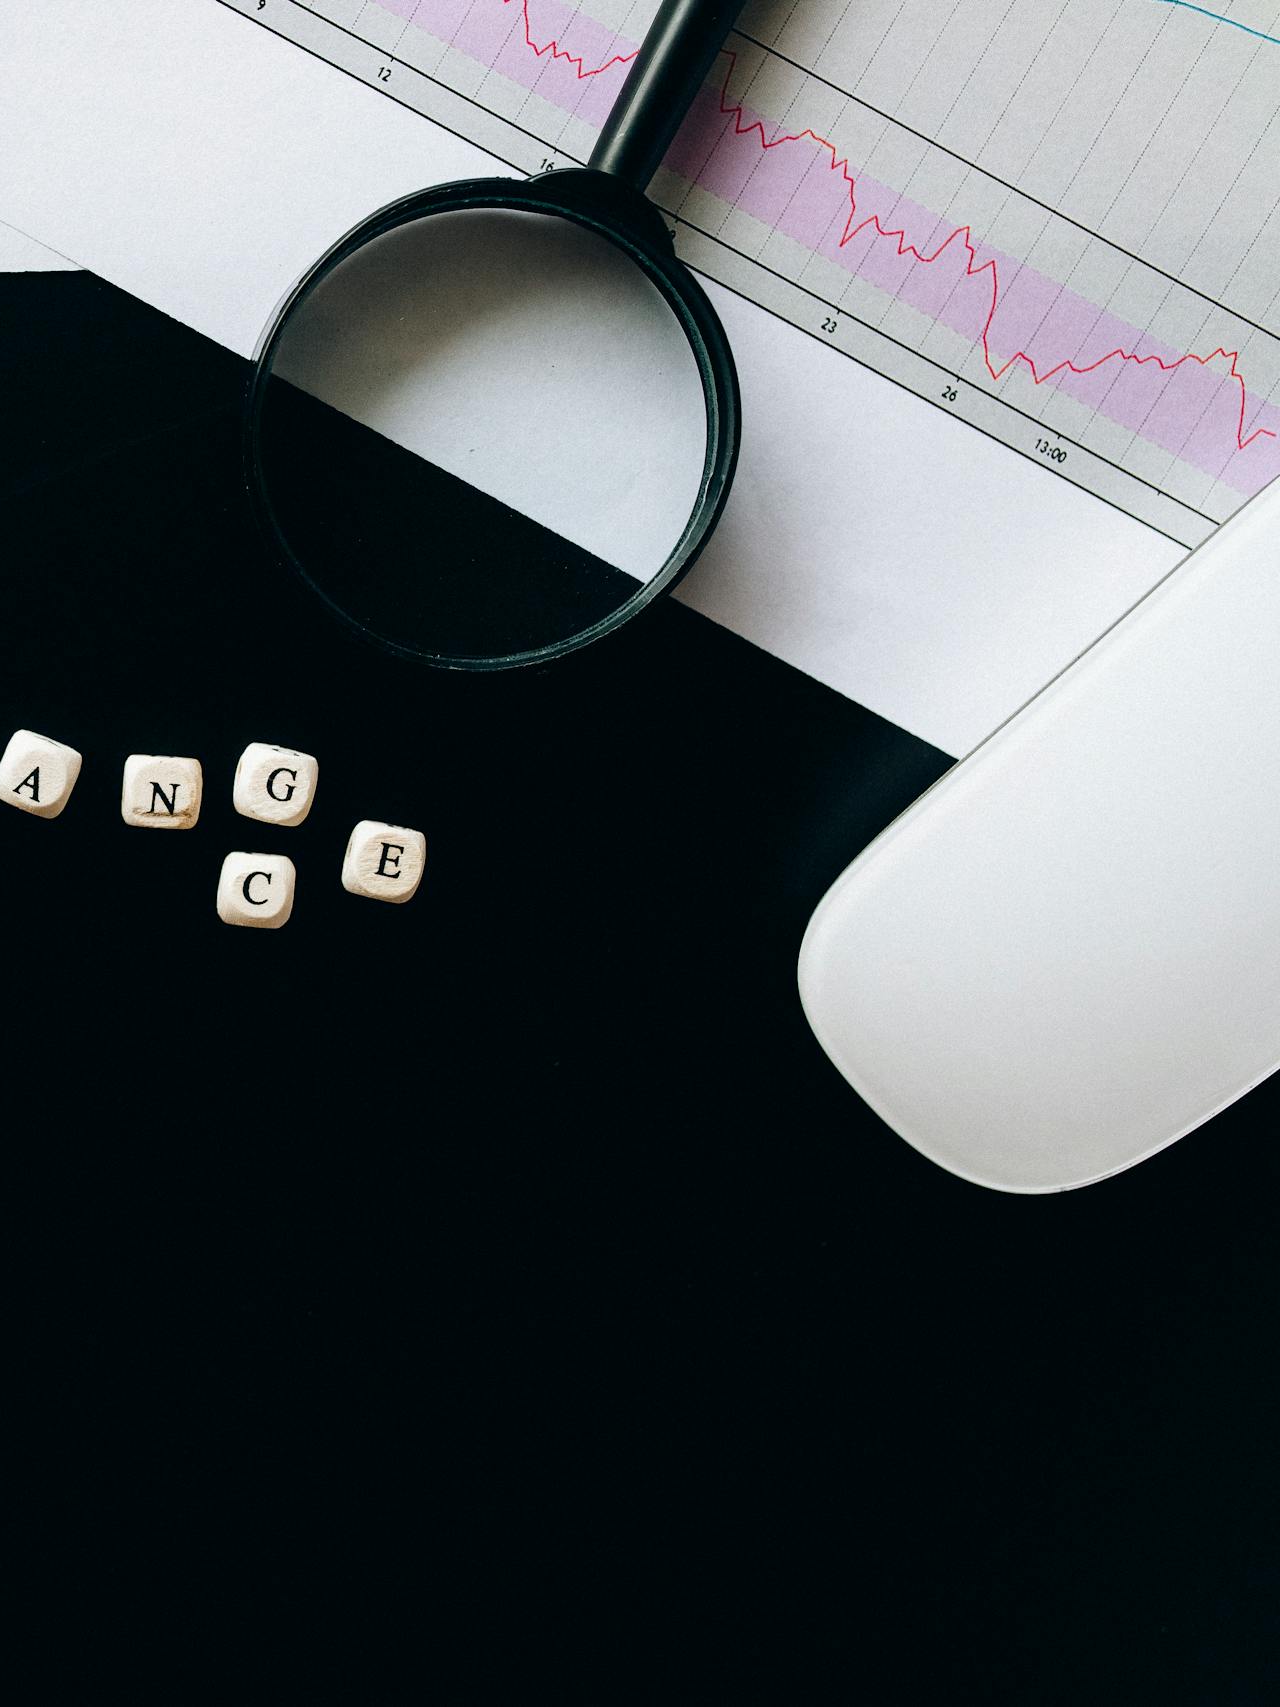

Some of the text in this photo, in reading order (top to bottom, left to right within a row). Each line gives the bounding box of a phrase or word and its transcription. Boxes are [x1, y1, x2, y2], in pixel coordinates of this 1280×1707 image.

[377, 66, 392, 82] 12
[540, 158, 555, 172] 16
[821, 316, 838, 334] 23
[941, 385, 959, 402] 26
[1035, 438, 1068, 464] 13:00
[242, 871, 272, 906] C
